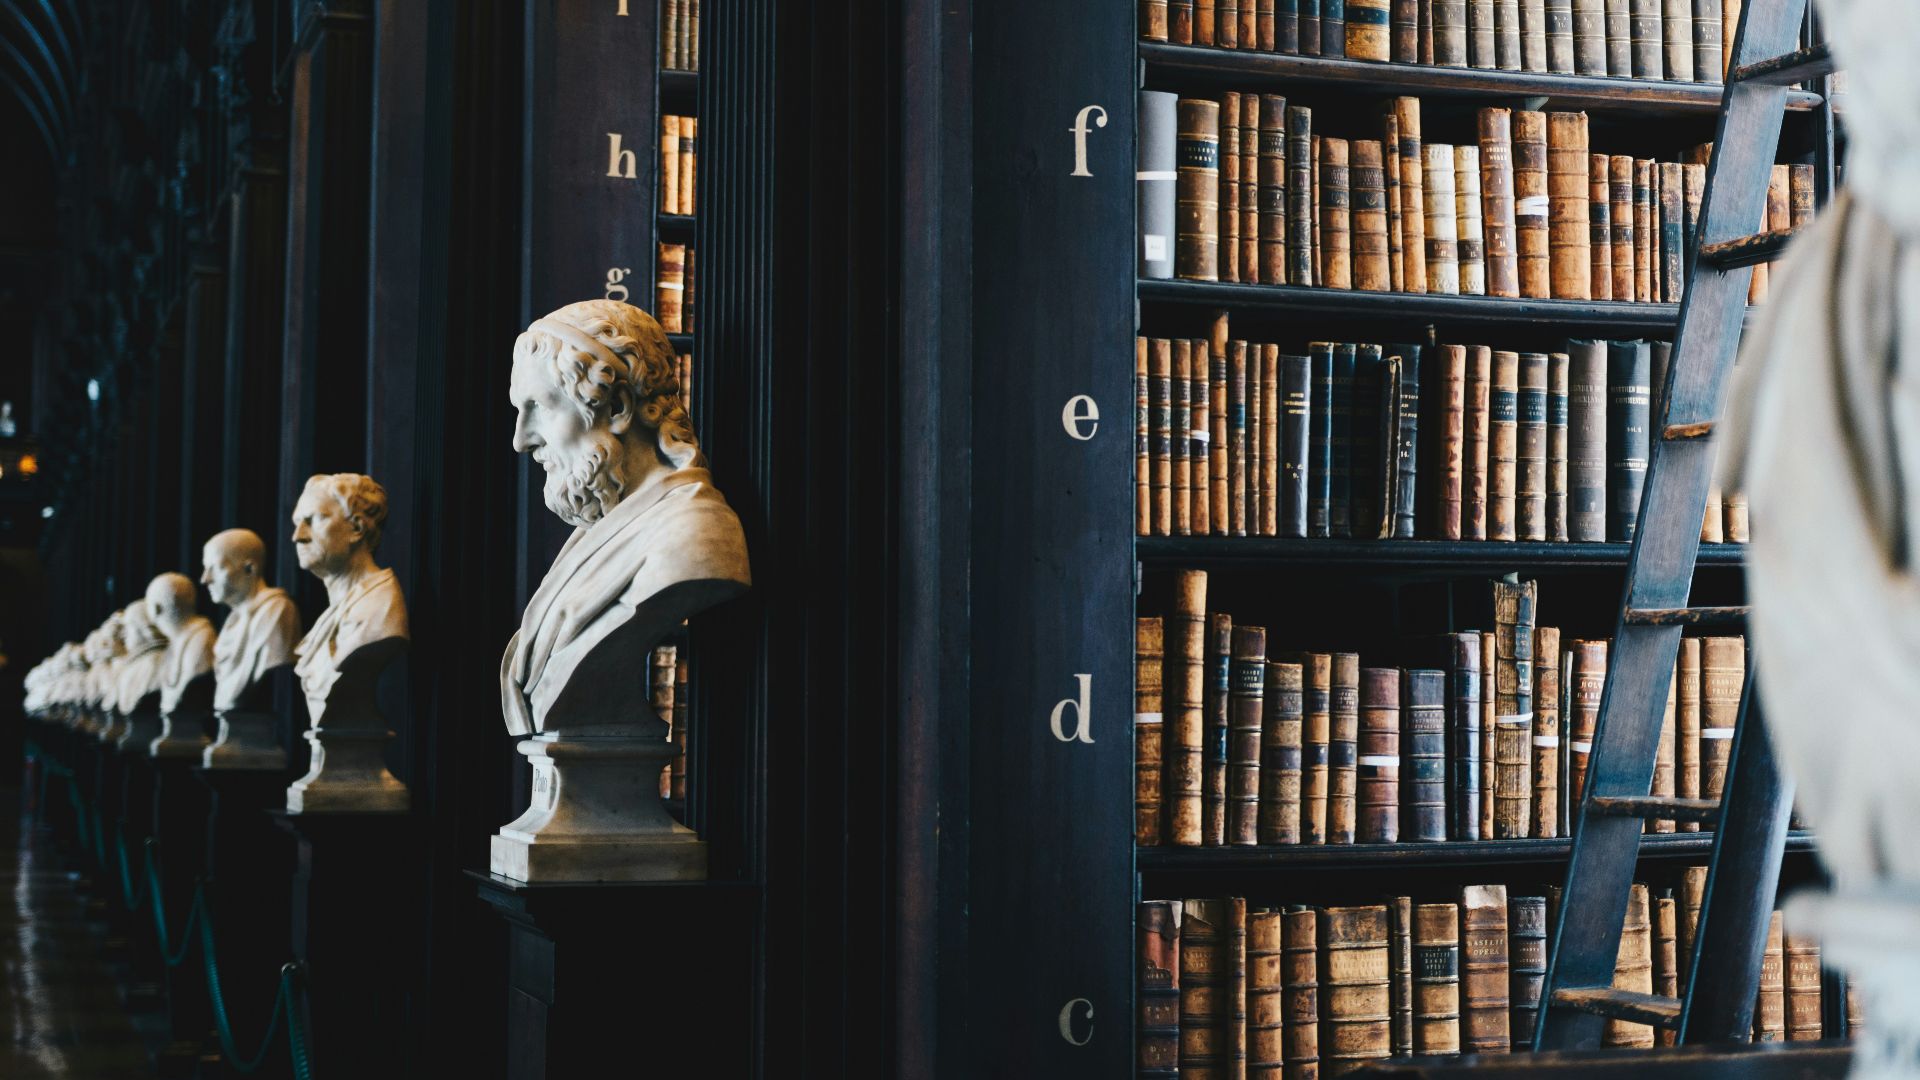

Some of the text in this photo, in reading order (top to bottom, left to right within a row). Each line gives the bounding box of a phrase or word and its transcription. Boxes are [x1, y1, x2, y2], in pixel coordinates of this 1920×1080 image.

[606, 132, 637, 179] h
[1068, 104, 1108, 177] f
[604, 266, 632, 303] g
[1061, 394, 1100, 441] e
[1050, 673, 1096, 744] d
[1058, 997, 1095, 1047] c
